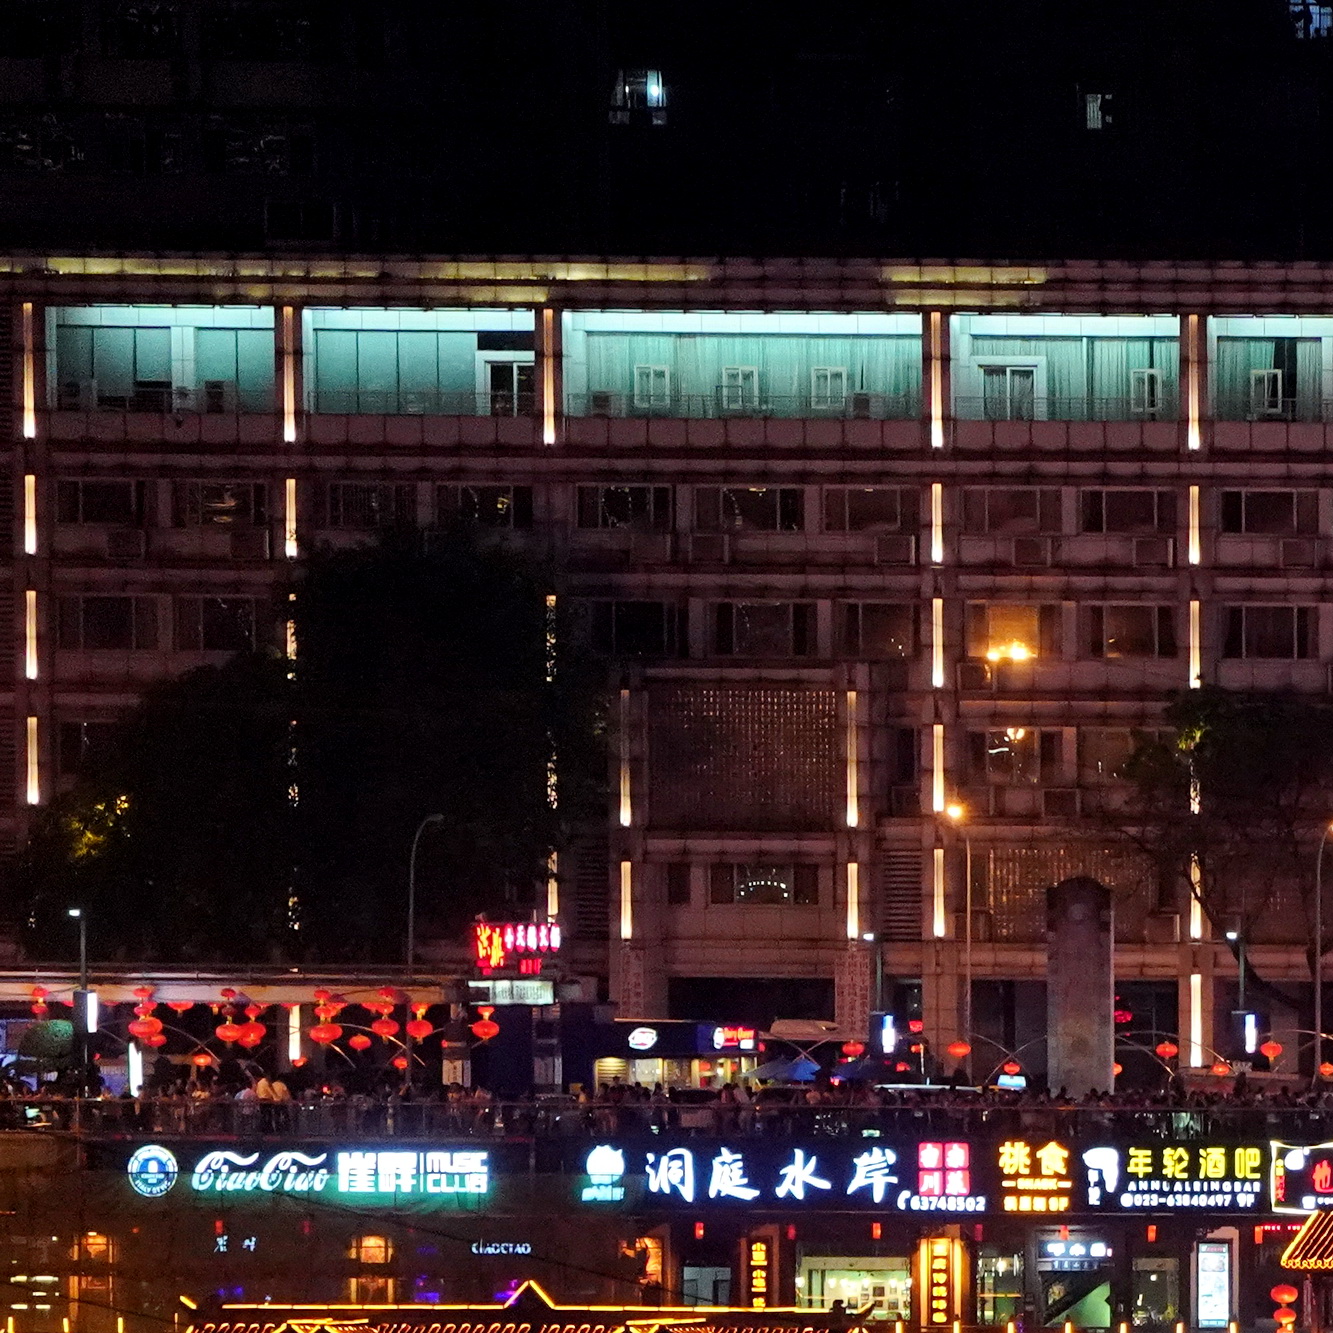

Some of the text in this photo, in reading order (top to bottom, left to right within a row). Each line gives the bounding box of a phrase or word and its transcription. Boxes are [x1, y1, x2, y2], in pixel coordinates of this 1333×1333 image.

[644, 1146, 899, 1204] 洞庭水岸
[1126, 1146, 1262, 1180] 年轮酒吧
